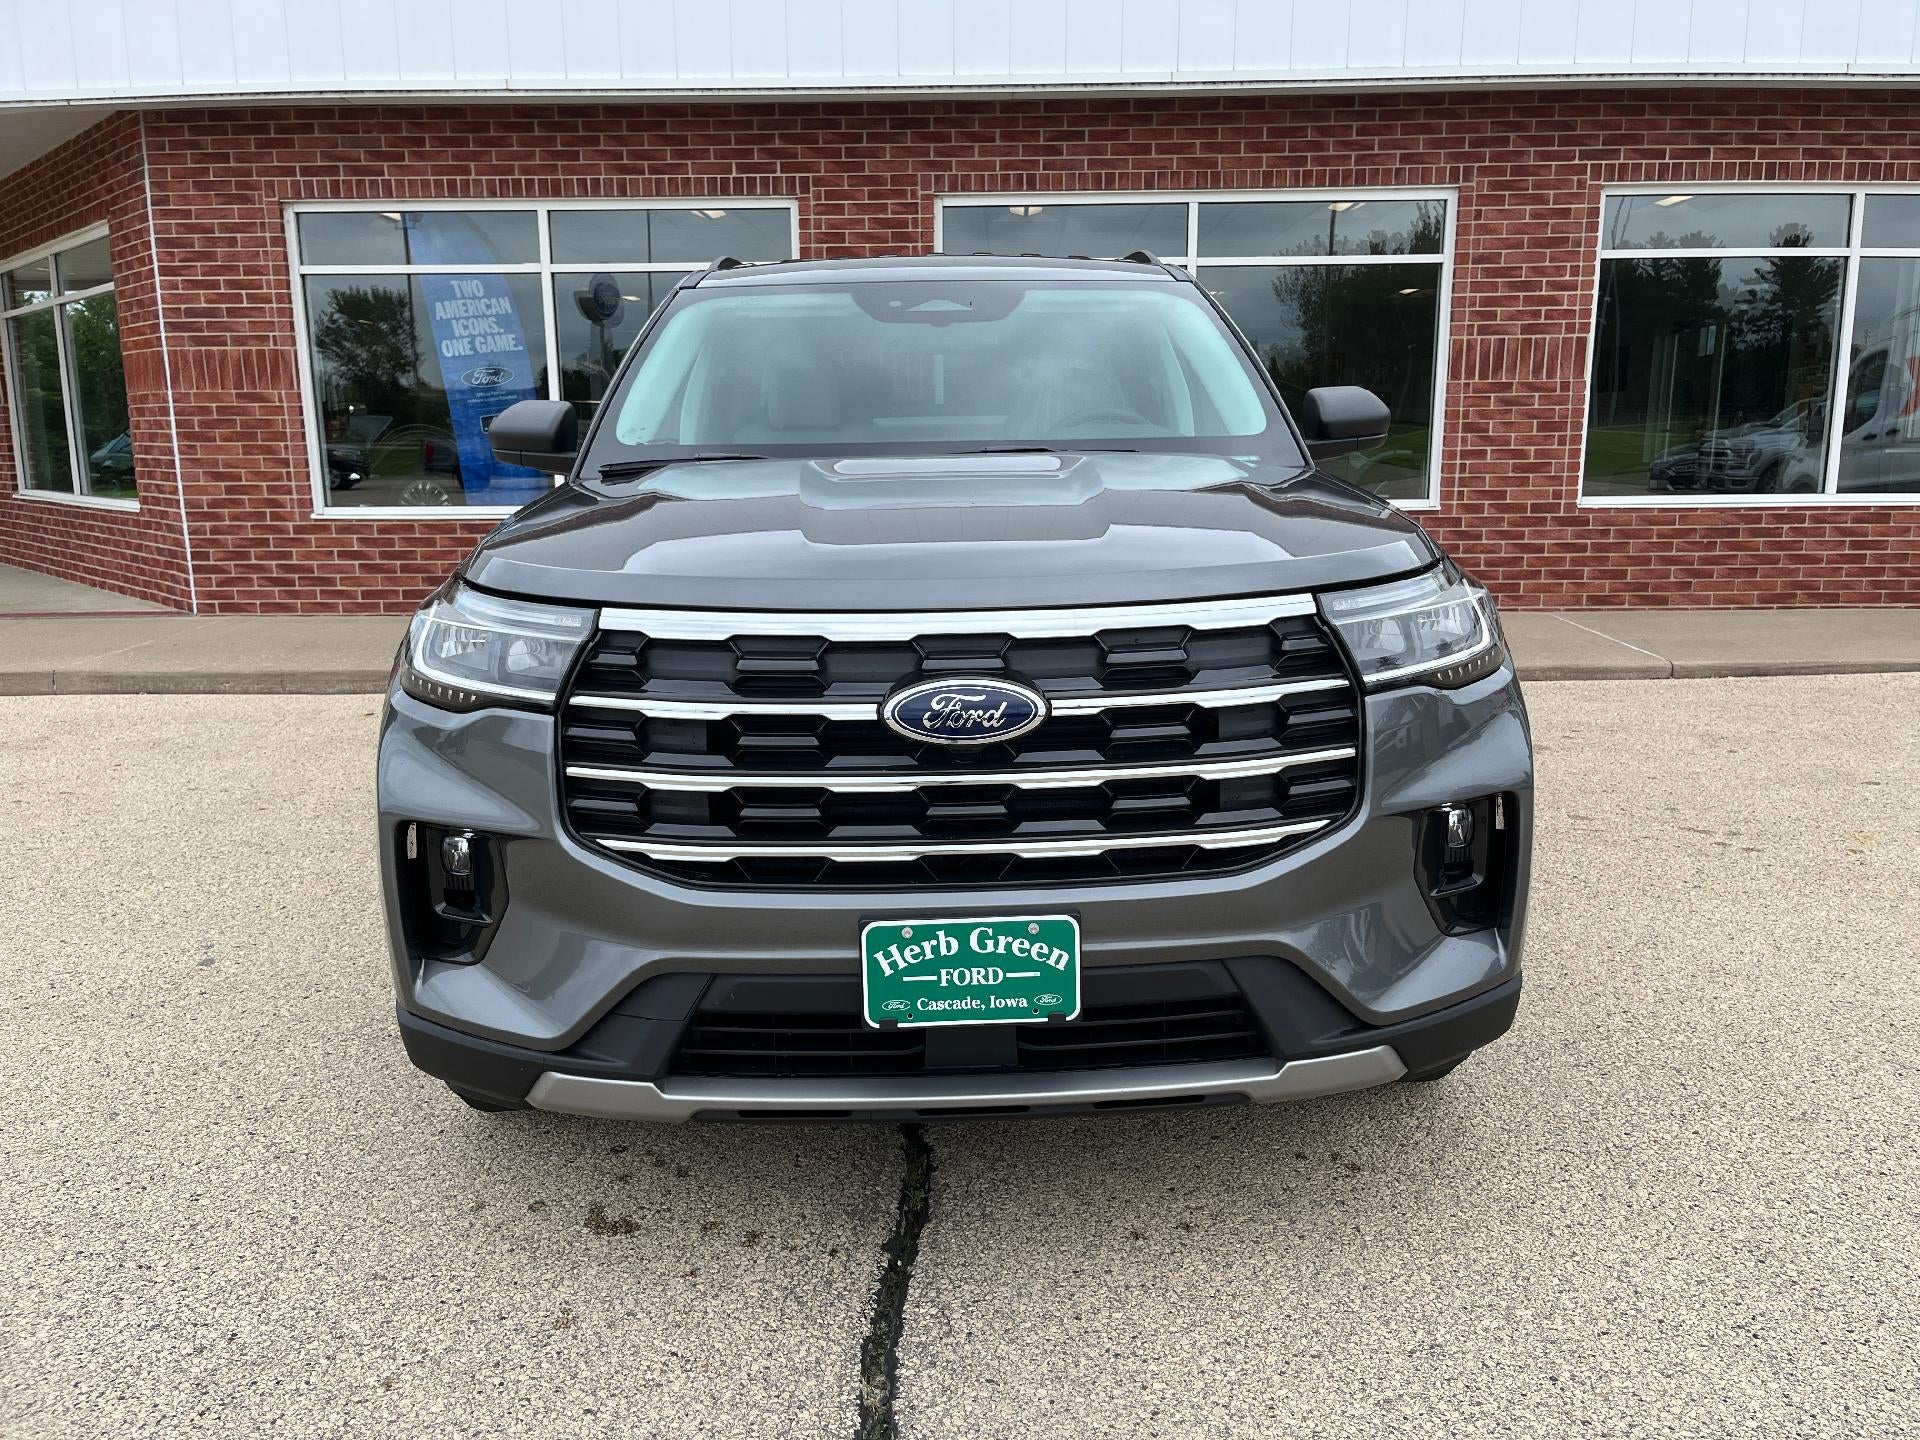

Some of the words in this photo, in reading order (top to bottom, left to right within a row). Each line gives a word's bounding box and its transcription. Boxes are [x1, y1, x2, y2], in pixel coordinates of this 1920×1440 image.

[451, 279, 484, 298] TWO
[436, 297, 512, 321] AMERICAN
[452, 317, 504, 337] ICONS.
[441, 339, 474, 357] ONE
[475, 334, 523, 355] GAME.
[471, 369, 504, 385] Ford
[922, 693, 1008, 729] Ford
[873, 930, 959, 977] Herb
[969, 927, 1070, 971] Green
[939, 967, 1004, 987] FORD
[917, 996, 986, 1011] Cascade,
[990, 995, 1028, 1009] Iowa
